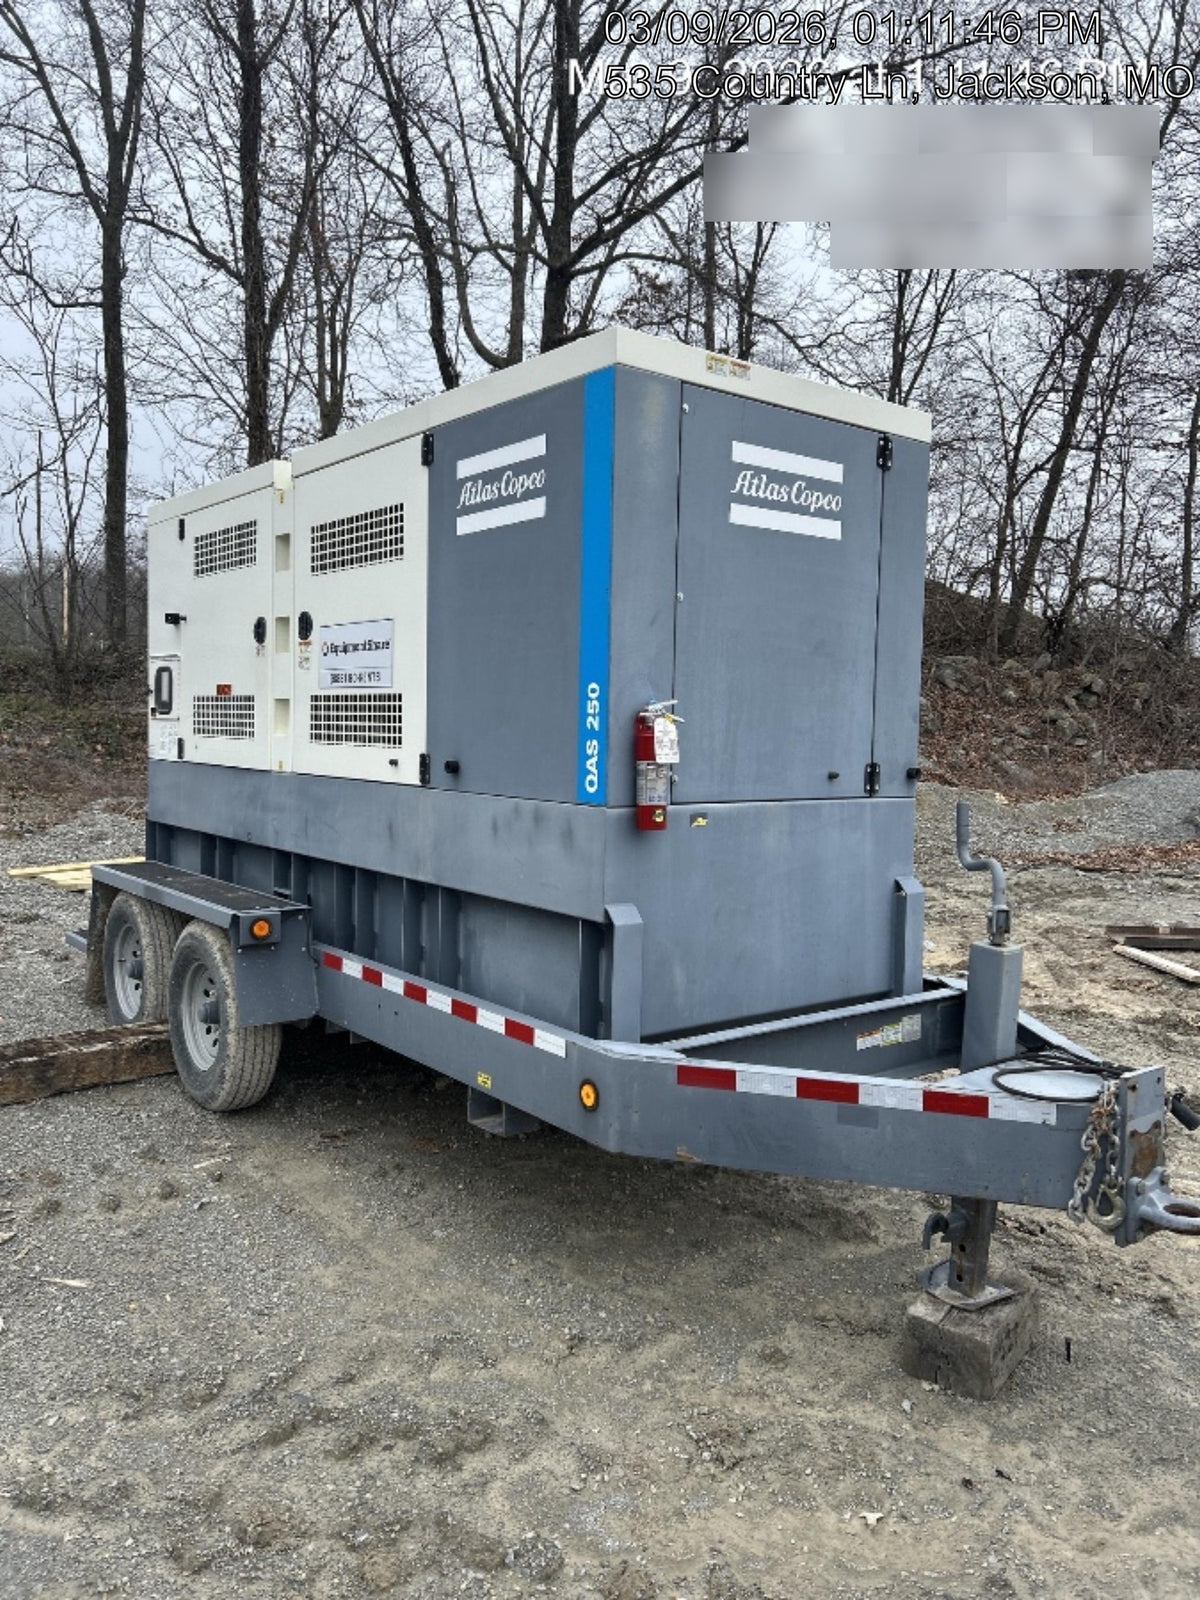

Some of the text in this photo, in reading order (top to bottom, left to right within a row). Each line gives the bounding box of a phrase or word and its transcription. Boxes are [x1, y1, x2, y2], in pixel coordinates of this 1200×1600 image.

[456, 468, 546, 509] Atlas Copco
[730, 470, 842, 513] Atlas Copco
[585, 682, 600, 794] QAS 250
